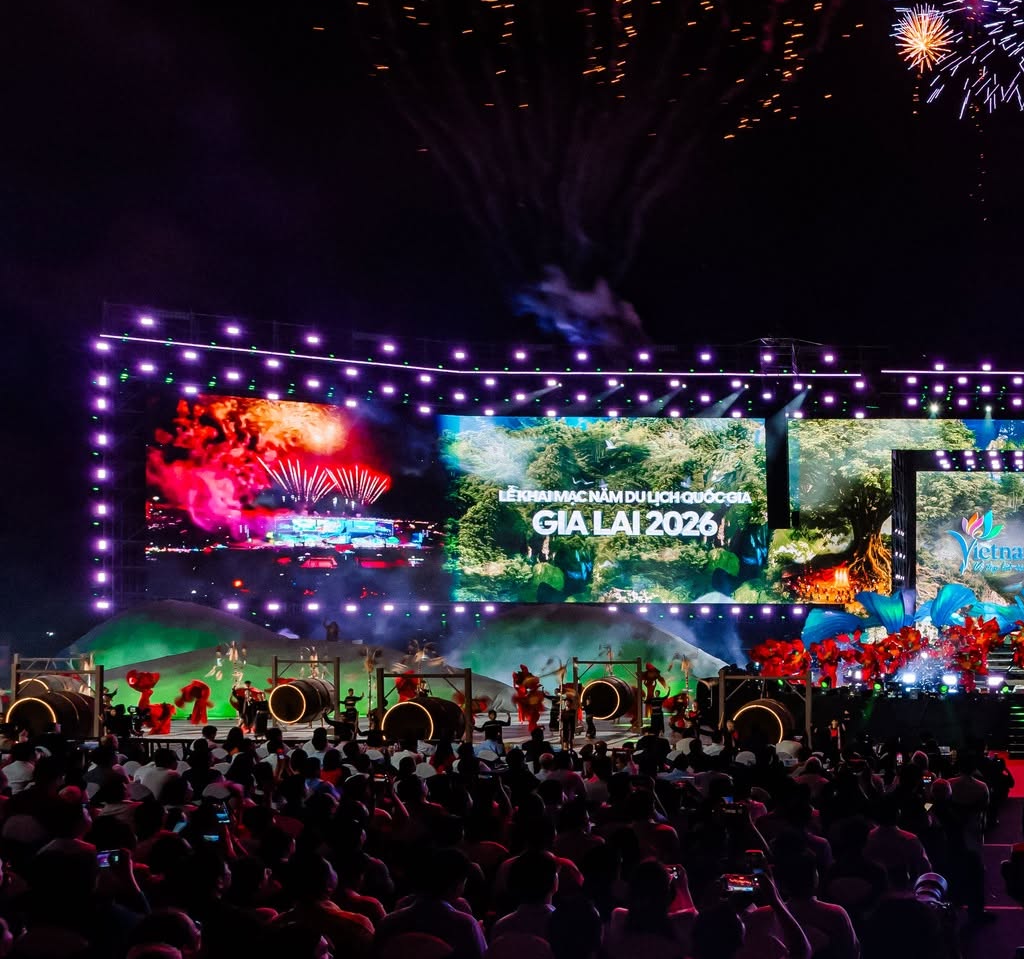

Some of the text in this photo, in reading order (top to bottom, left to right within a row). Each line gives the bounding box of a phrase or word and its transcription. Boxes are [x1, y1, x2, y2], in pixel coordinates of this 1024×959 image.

[517, 490, 552, 502] KHAI
[554, 490, 588, 506] MẠC
[625, 490, 646, 503] DU
[647, 491, 680, 506] LỊCH
[680, 486, 725, 504] QUỐC
[725, 491, 752, 504] GIA
[532, 509, 718, 536] GIA LAI 2026
